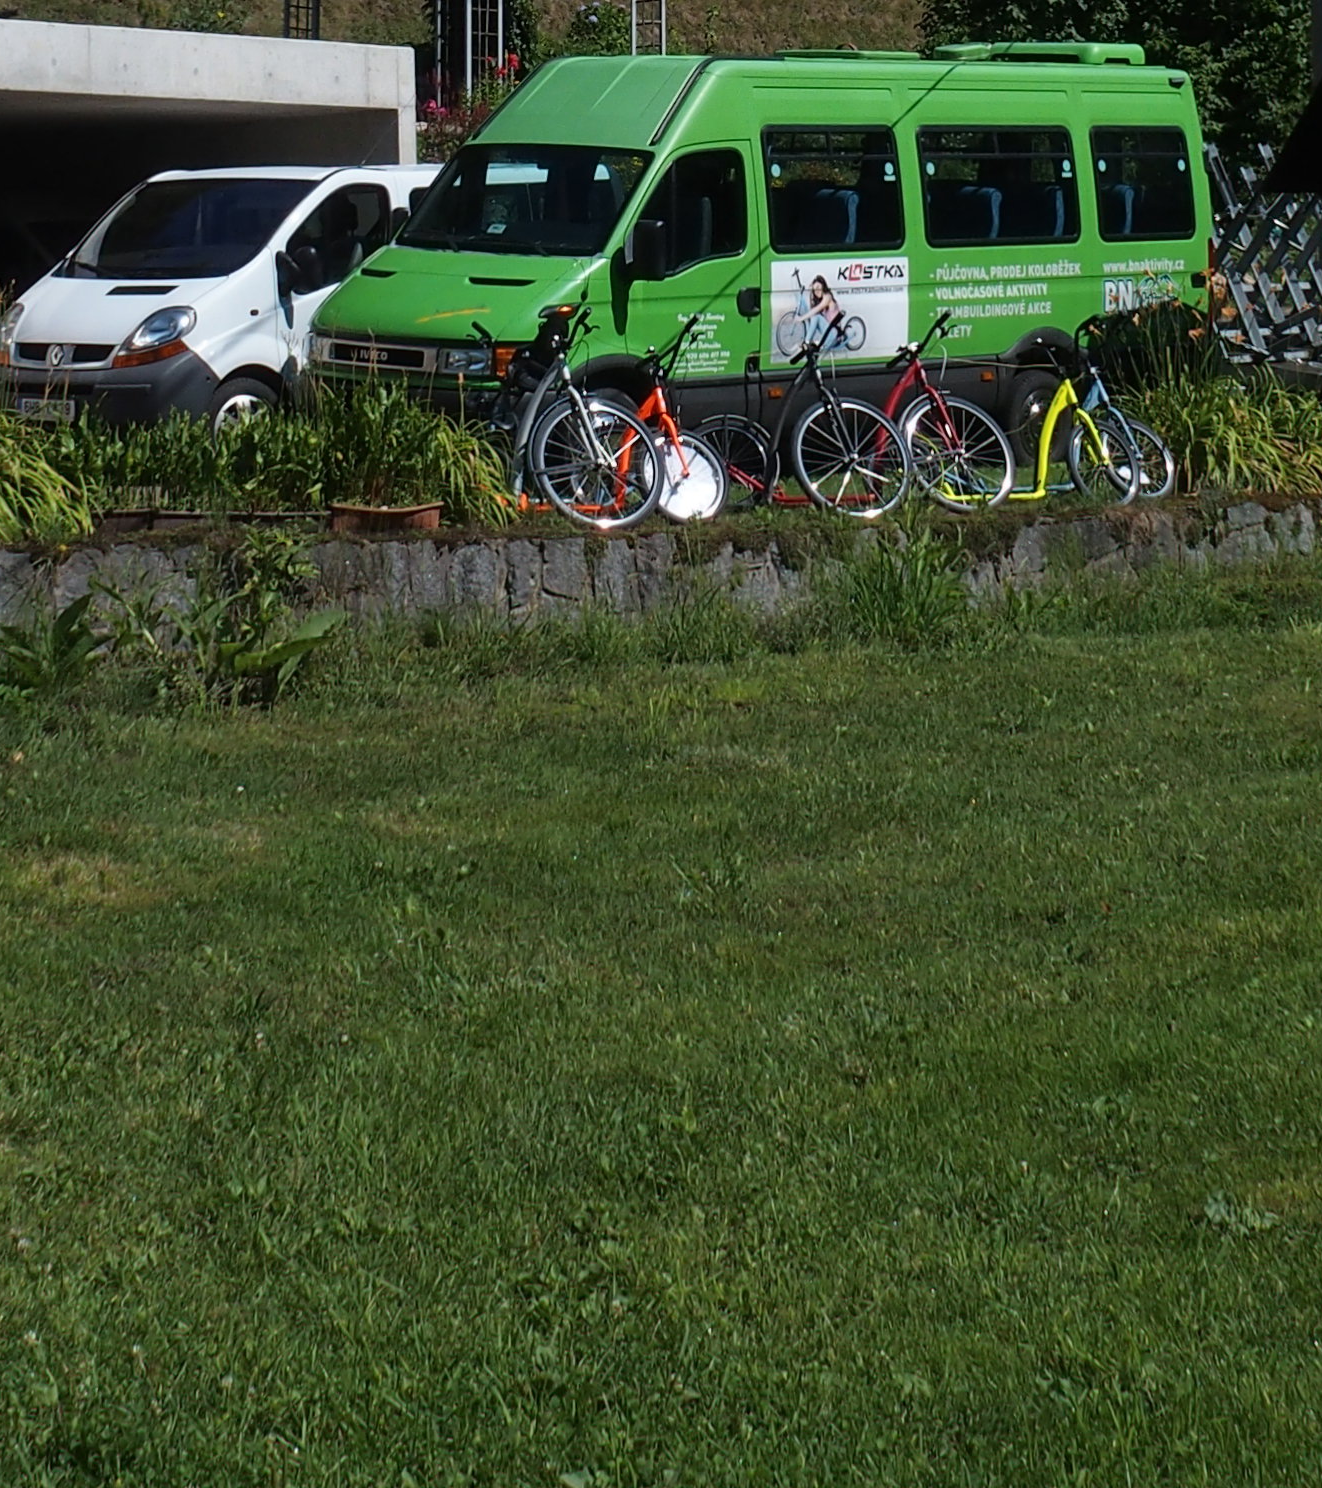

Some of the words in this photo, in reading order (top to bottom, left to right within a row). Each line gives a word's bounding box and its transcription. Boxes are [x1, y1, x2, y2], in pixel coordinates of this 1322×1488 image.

[837, 264, 904, 281] KOSTKA
[936, 263, 989, 281] PŮJČOVNA,
[990, 265, 1026, 279] PRODEJ
[1028, 260, 1081, 276] KOLOBĚŽEK
[1103, 258, 1184, 273] www.bnaktivity.cz
[935, 282, 1004, 300] VOLNOČASOVÉ
[1006, 283, 1048, 297] AKTIVITY
[1103, 279, 1133, 312] BN
[1028, 302, 1052, 314] AKCE
[360, 348, 388, 361] IVCO
